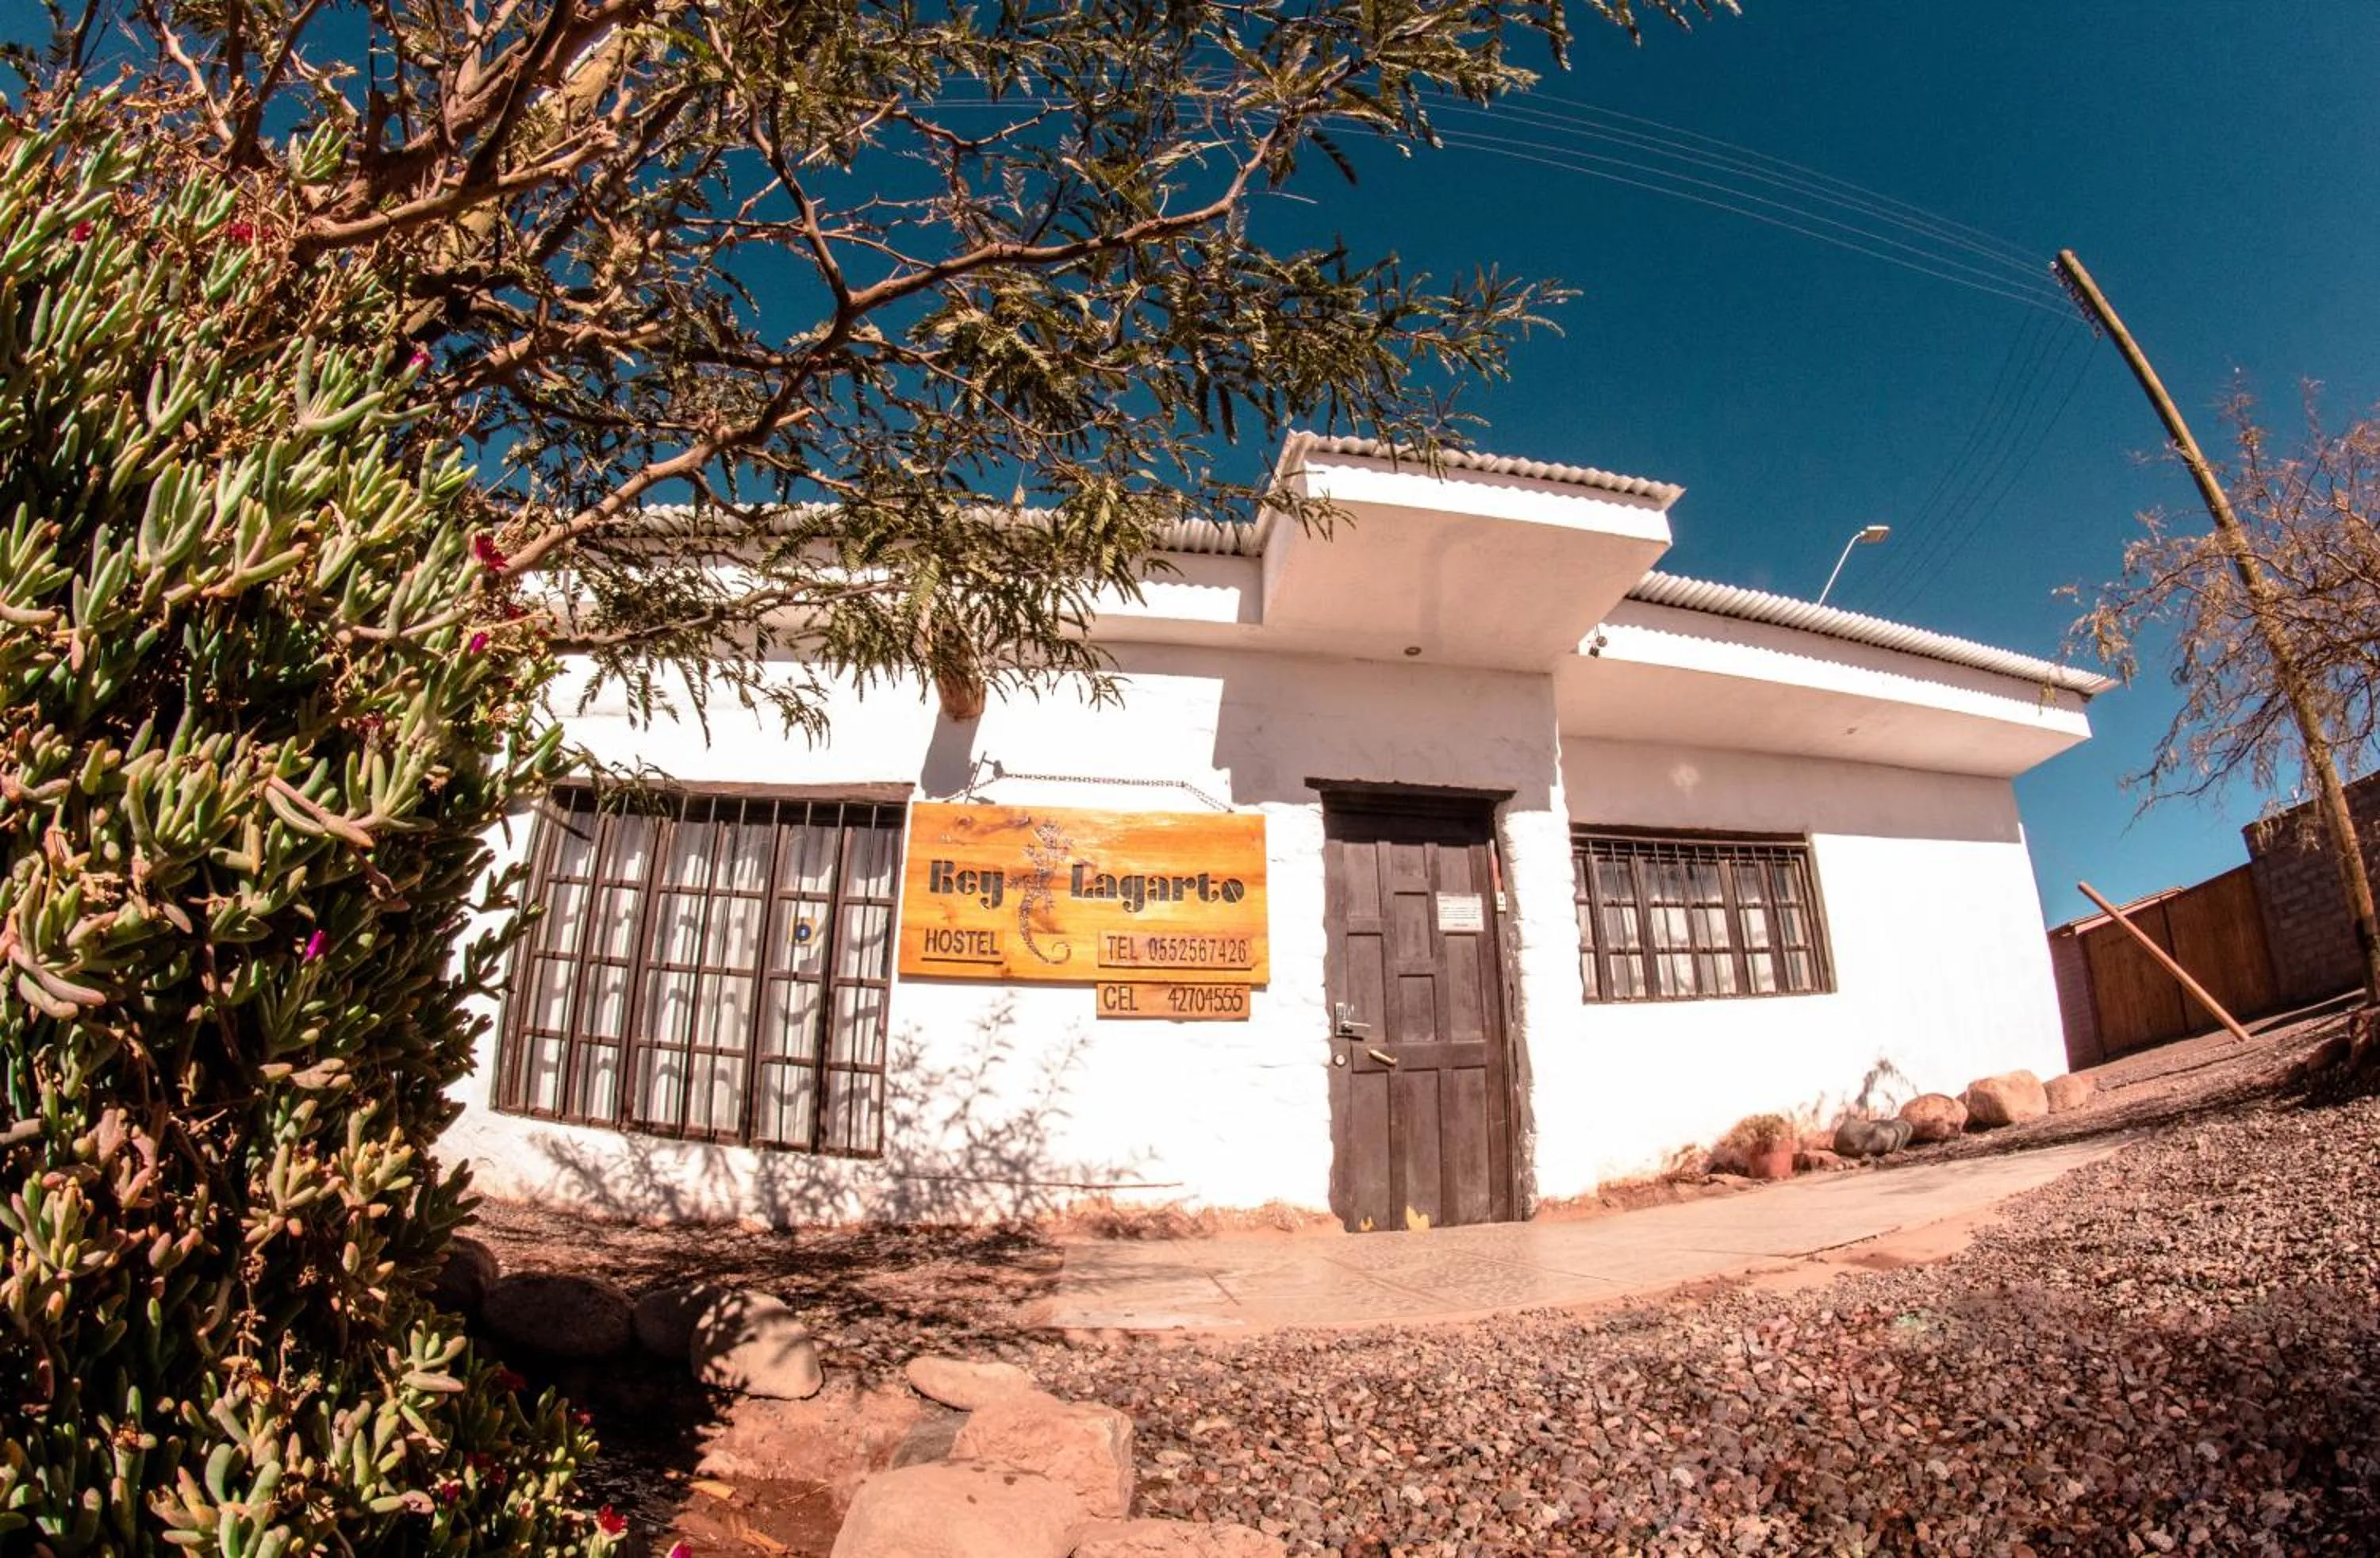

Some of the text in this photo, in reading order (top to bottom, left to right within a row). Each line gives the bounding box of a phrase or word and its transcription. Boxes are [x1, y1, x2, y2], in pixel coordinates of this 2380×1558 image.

[930, 860, 1245, 913] Rey Lagarto
[924, 928, 1000, 955] HOSTEL
[1107, 936, 1246, 963] TEL 0552567426
[1104, 986, 1243, 1012] CEL 42704555
